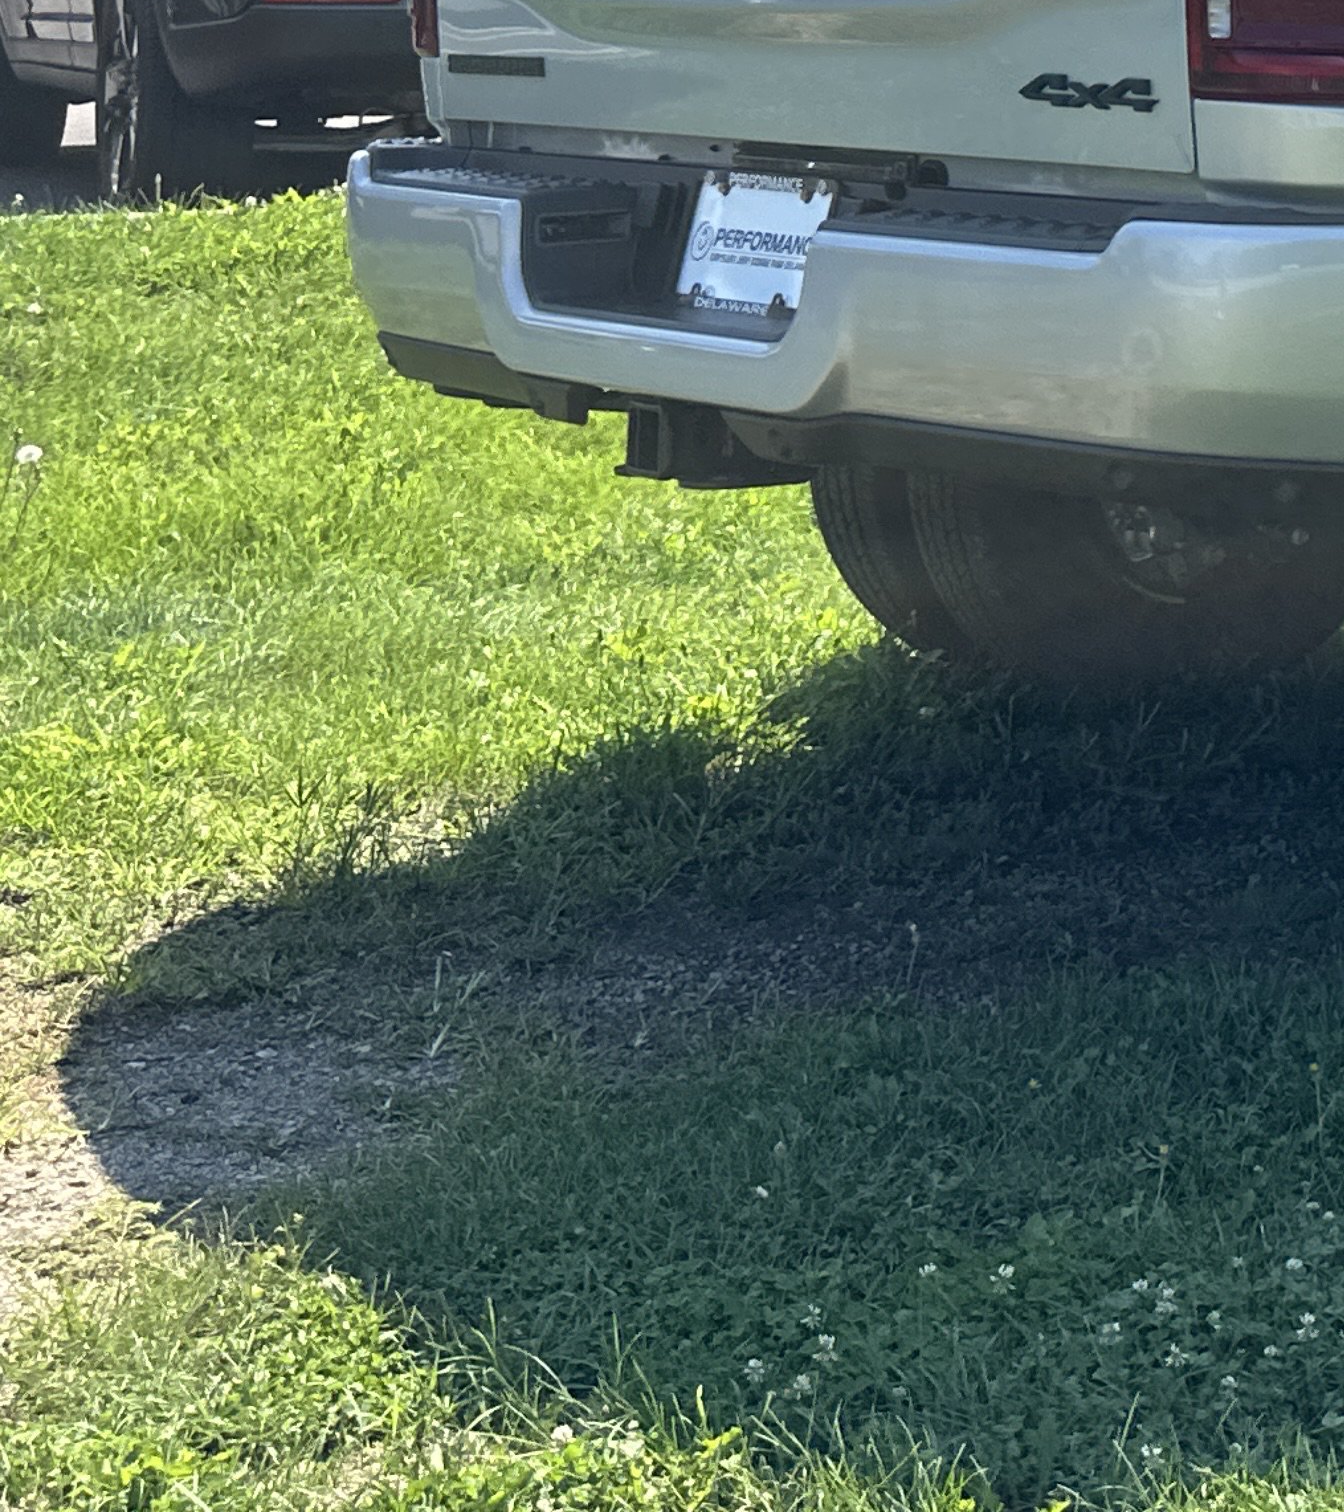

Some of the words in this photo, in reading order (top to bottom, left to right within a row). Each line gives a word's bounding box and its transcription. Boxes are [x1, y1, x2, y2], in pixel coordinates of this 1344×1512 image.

[729, 172, 804, 191] PERFORMANCE
[713, 228, 812, 255] PERFORMANC
[694, 297, 768, 317] DELAWARE
